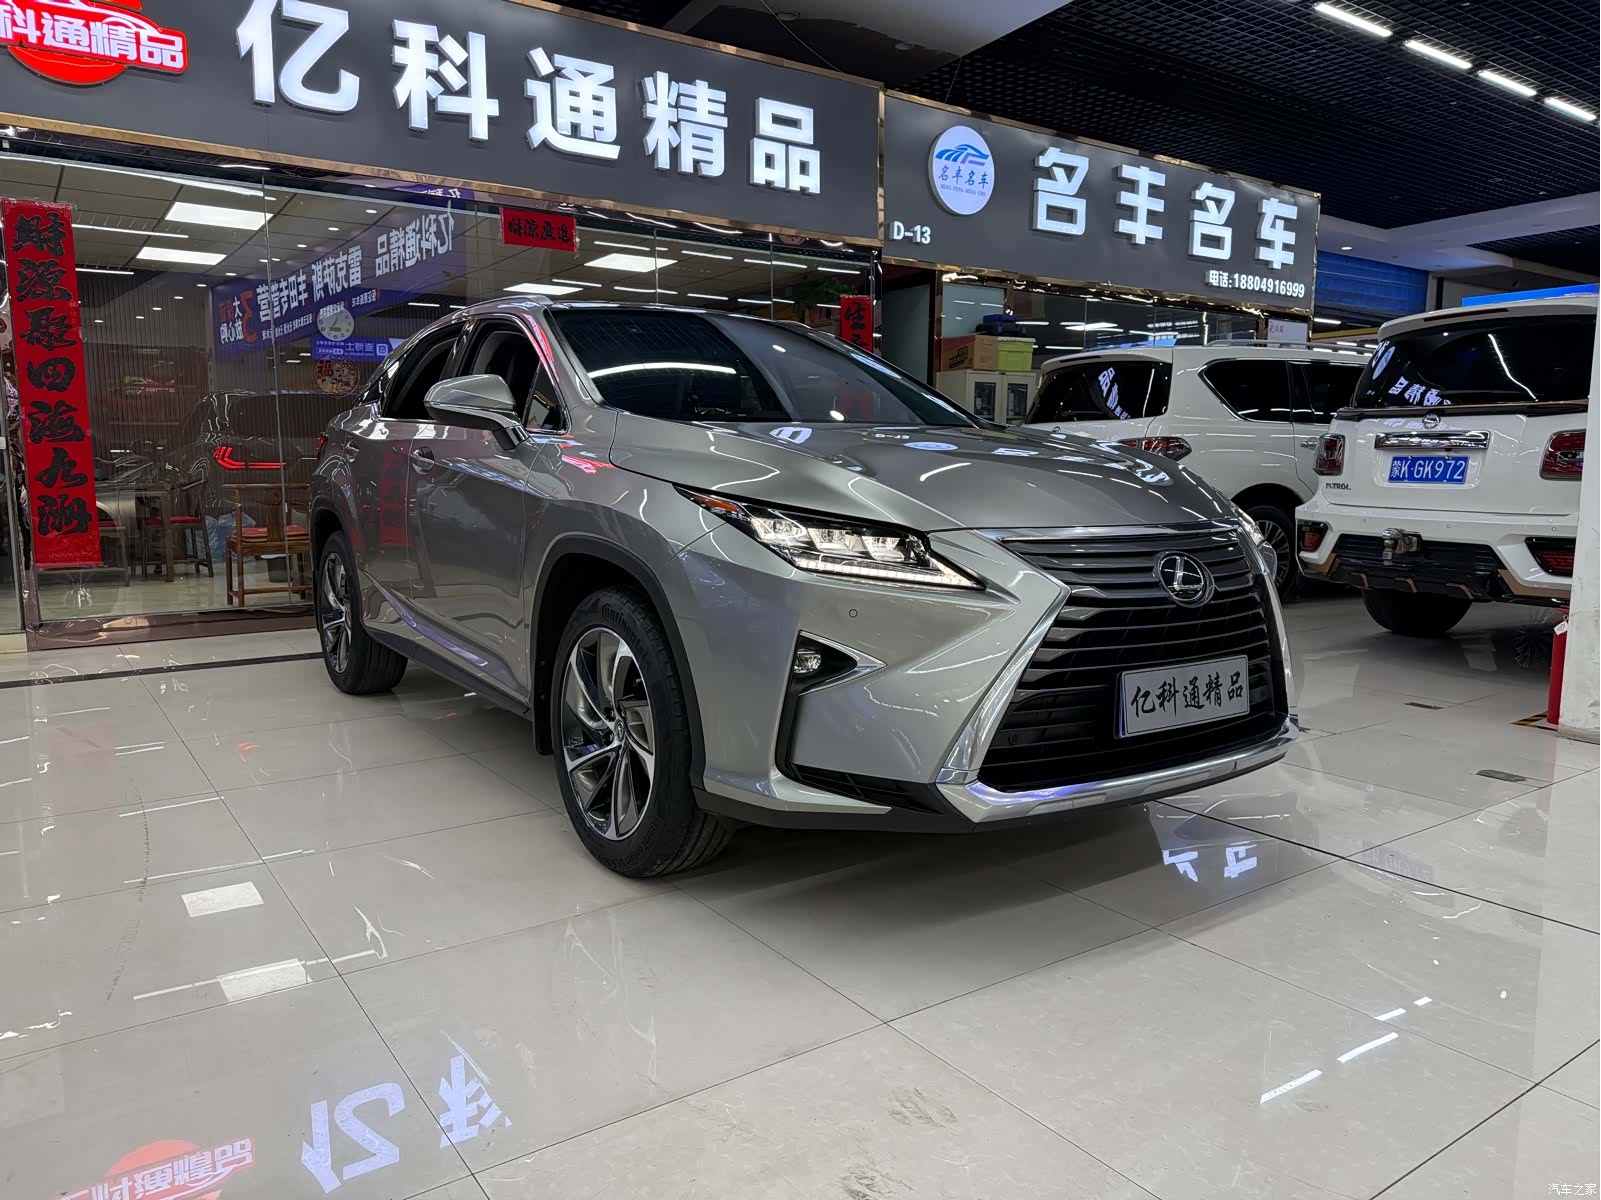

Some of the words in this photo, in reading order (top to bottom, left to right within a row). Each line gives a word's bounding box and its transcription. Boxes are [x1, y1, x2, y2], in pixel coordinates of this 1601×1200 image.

[235, 0, 821, 195] 亿科通精品
[938, 164, 989, 190] 名丰名车
[1033, 146, 1299, 270] 名丰名车
[893, 221, 931, 244] D-13
[1209, 270, 1305, 298] 电话:18804916999
[1326, 482, 1351, 491] PATROL
[1131, 671, 1243, 718] 亿科通精品
